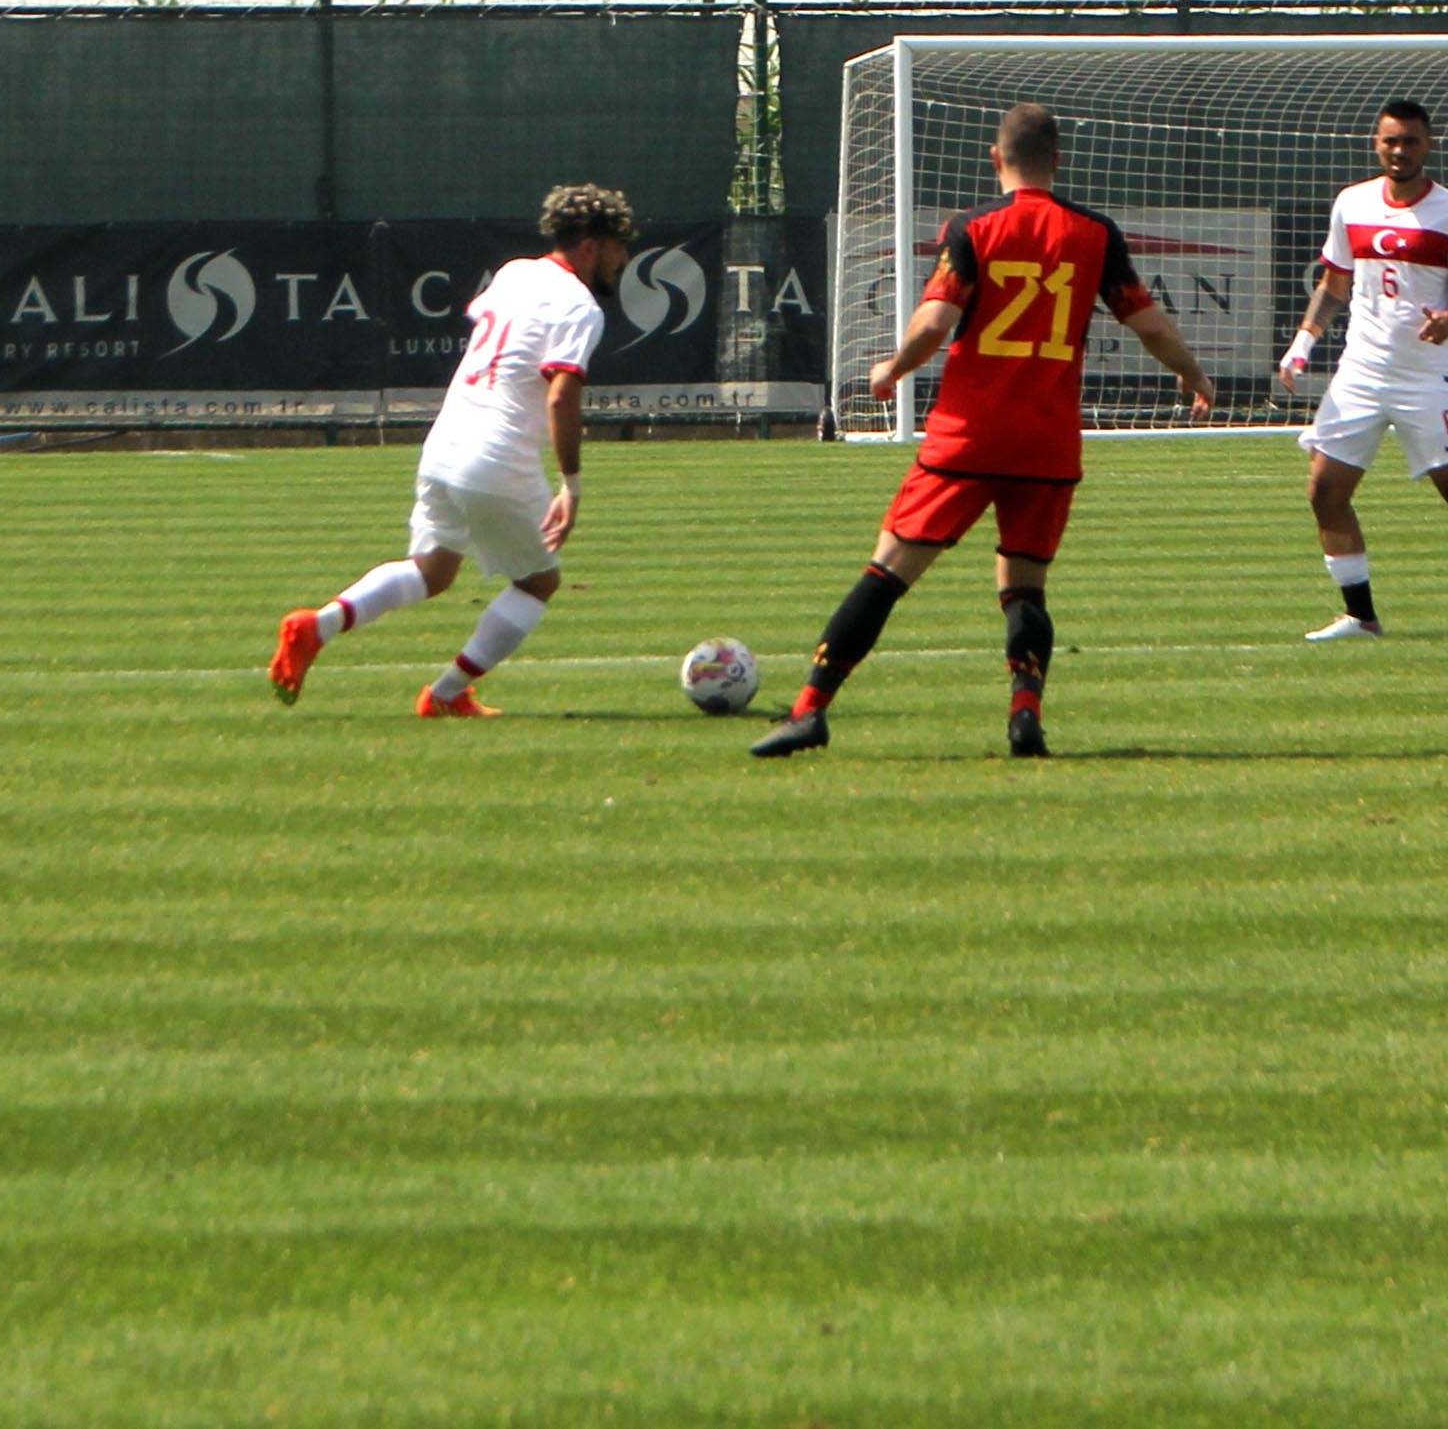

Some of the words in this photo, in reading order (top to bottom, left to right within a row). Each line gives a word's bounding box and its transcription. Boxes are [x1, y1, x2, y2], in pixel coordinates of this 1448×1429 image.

[1381, 267, 1400, 299] 6
[977, 259, 1075, 362] 21
[45, 339, 141, 360] RESORT
[389, 336, 468, 355] LUXUR
[464, 309, 514, 391] 21
[5, 398, 304, 417] www.calista.com.tr
[587, 389, 756, 409] ista.com.tr
